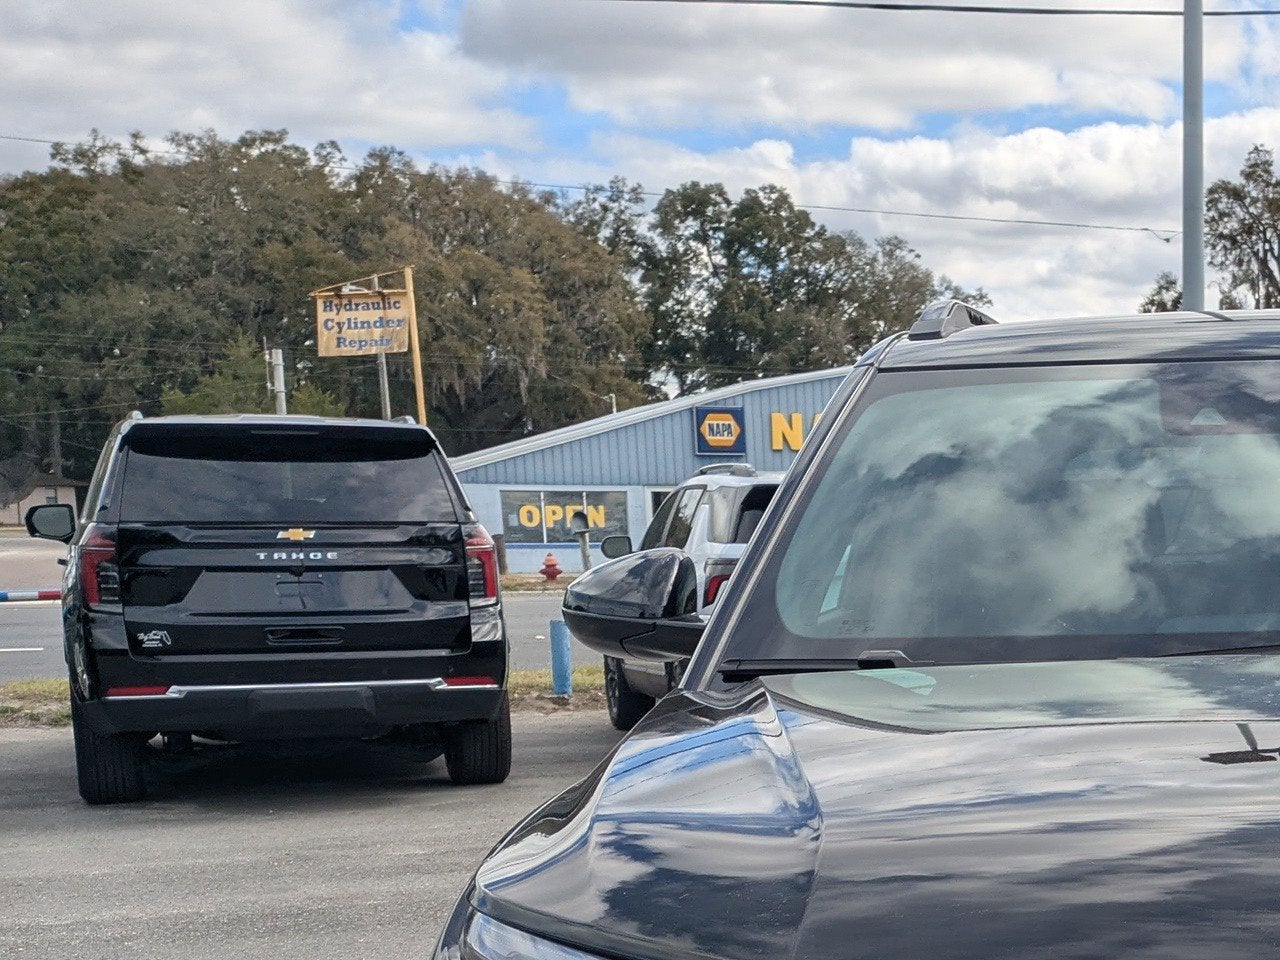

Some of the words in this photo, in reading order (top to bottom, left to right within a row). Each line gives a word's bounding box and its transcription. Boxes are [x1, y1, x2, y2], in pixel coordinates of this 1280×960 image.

[322, 298, 401, 315] Hydraulic
[323, 317, 404, 334] Cylinder
[336, 336, 392, 351] Repair
[708, 422, 733, 437] NAPA
[256, 552, 339, 560] TAHOE
